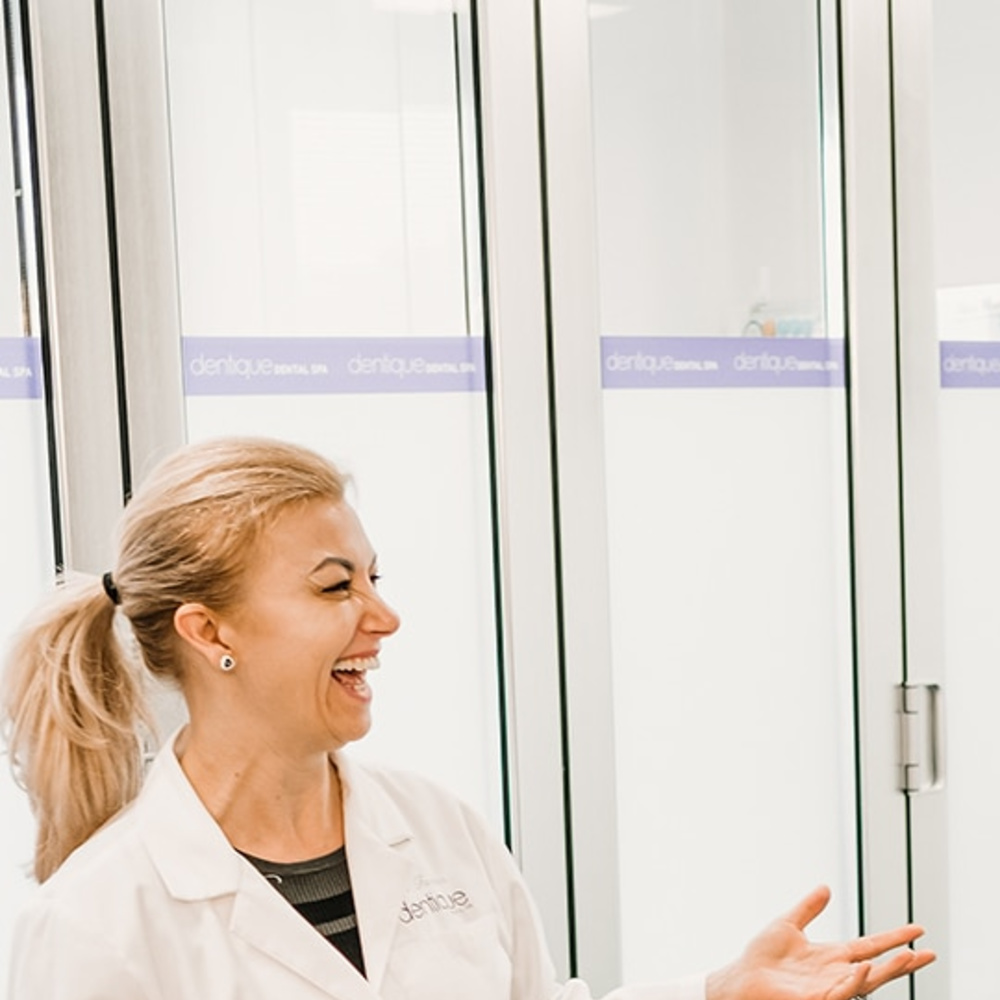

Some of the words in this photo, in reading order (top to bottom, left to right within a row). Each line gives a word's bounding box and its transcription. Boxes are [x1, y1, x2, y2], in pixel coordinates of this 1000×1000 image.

[189, 352, 274, 380] dentique
[346, 352, 426, 379] dentique
[605, 350, 673, 376] dentique
